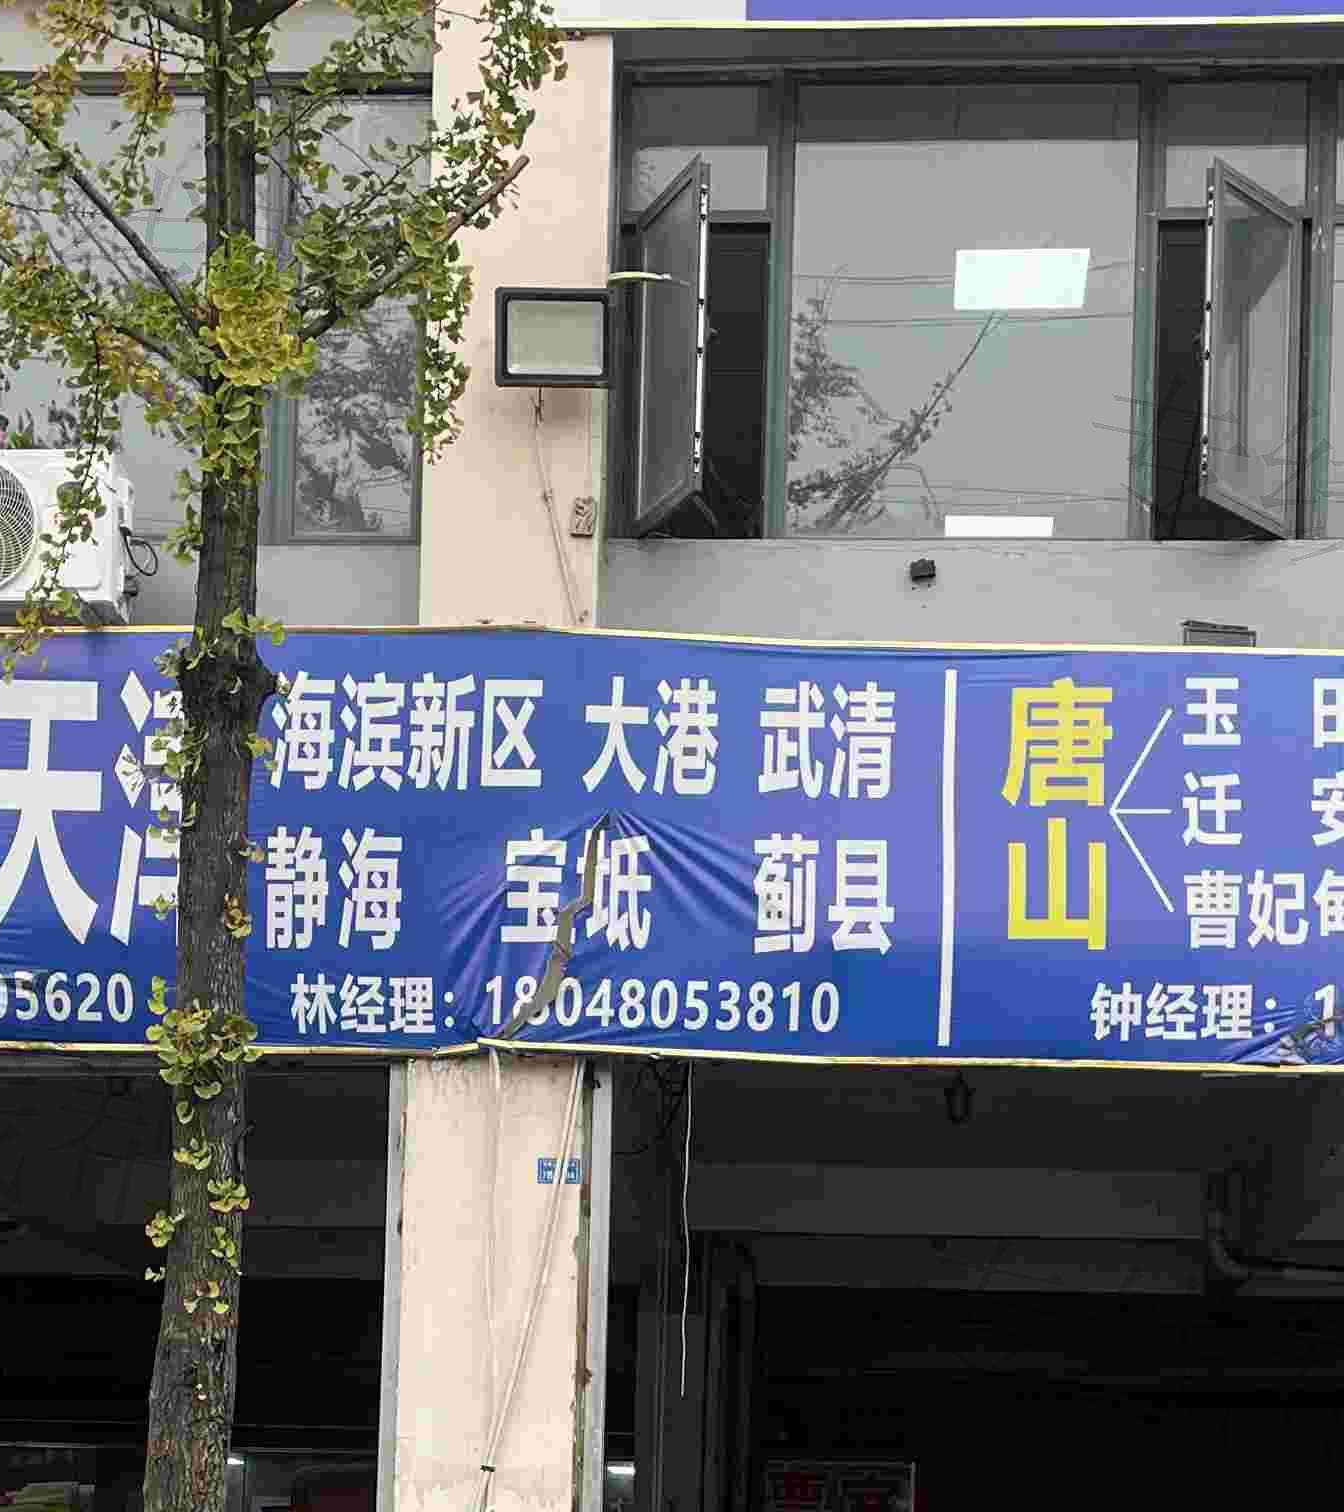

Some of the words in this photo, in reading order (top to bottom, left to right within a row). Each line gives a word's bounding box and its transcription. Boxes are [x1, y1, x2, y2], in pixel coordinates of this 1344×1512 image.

[272, 671, 544, 792] 海滨新区
[583, 676, 720, 797] 大港
[758, 680, 896, 799] 武清
[1001, 676, 1114, 950] 唐山
[265, 826, 403, 950] 静海
[753, 833, 896, 955] 蓟县
